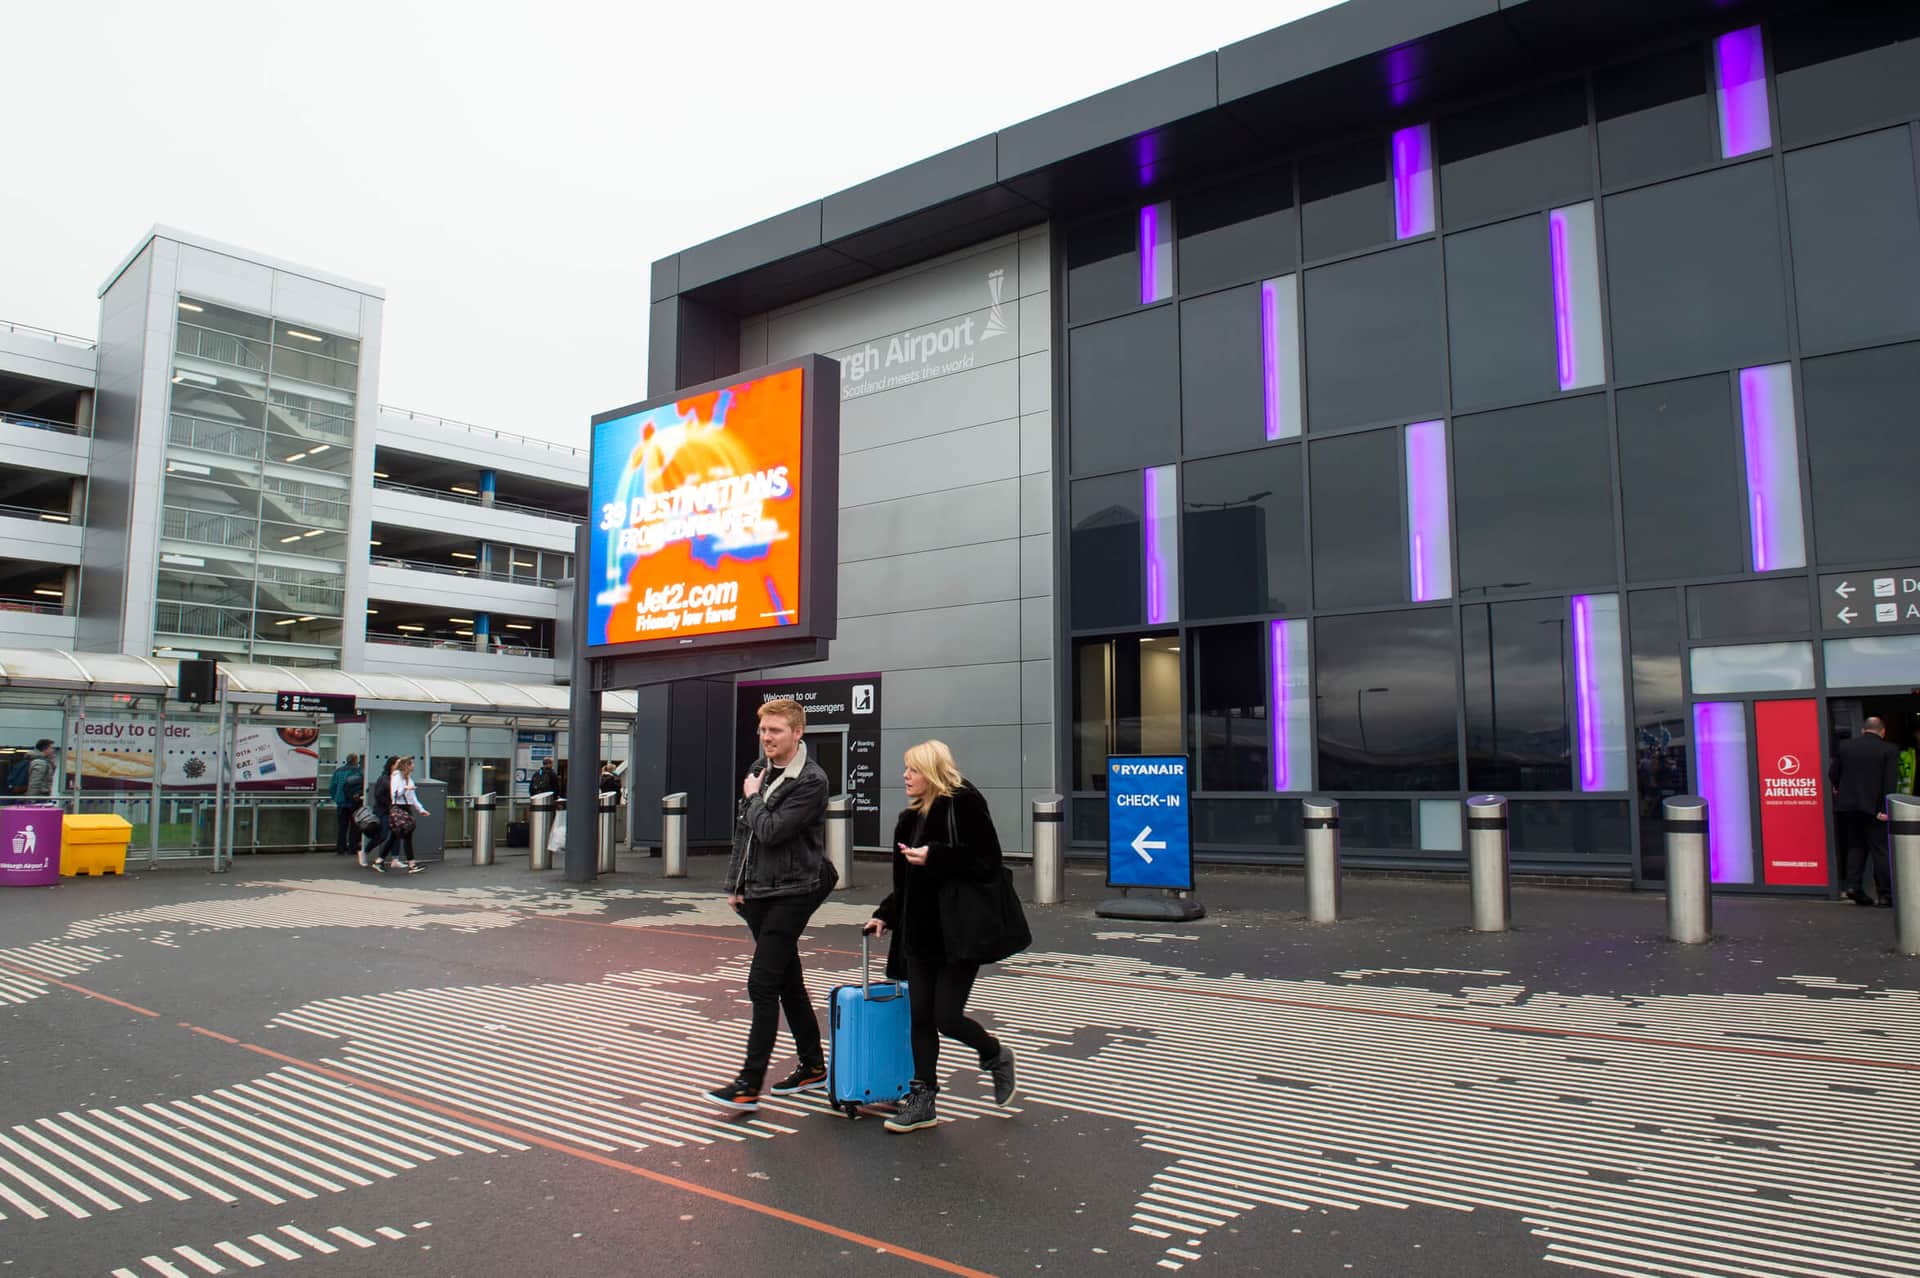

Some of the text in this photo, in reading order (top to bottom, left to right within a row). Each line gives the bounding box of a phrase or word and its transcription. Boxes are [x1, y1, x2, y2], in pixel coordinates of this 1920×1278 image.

[884, 316, 975, 362] Airport
[842, 352, 976, 399] Scotland meets the world
[630, 466, 788, 526] DESTINATIONS
[637, 581, 738, 614] Jet2.com
[635, 606, 738, 632] Friendly low fares
[795, 691, 803, 701] to
[804, 692, 817, 701] our
[128, 723, 145, 736] to
[1121, 764, 1184, 775] RYANAIR
[1764, 778, 1816, 788] TURKISH
[1764, 788, 1817, 797] AIRLINES
[1117, 794, 1180, 807] CHECK-IN
